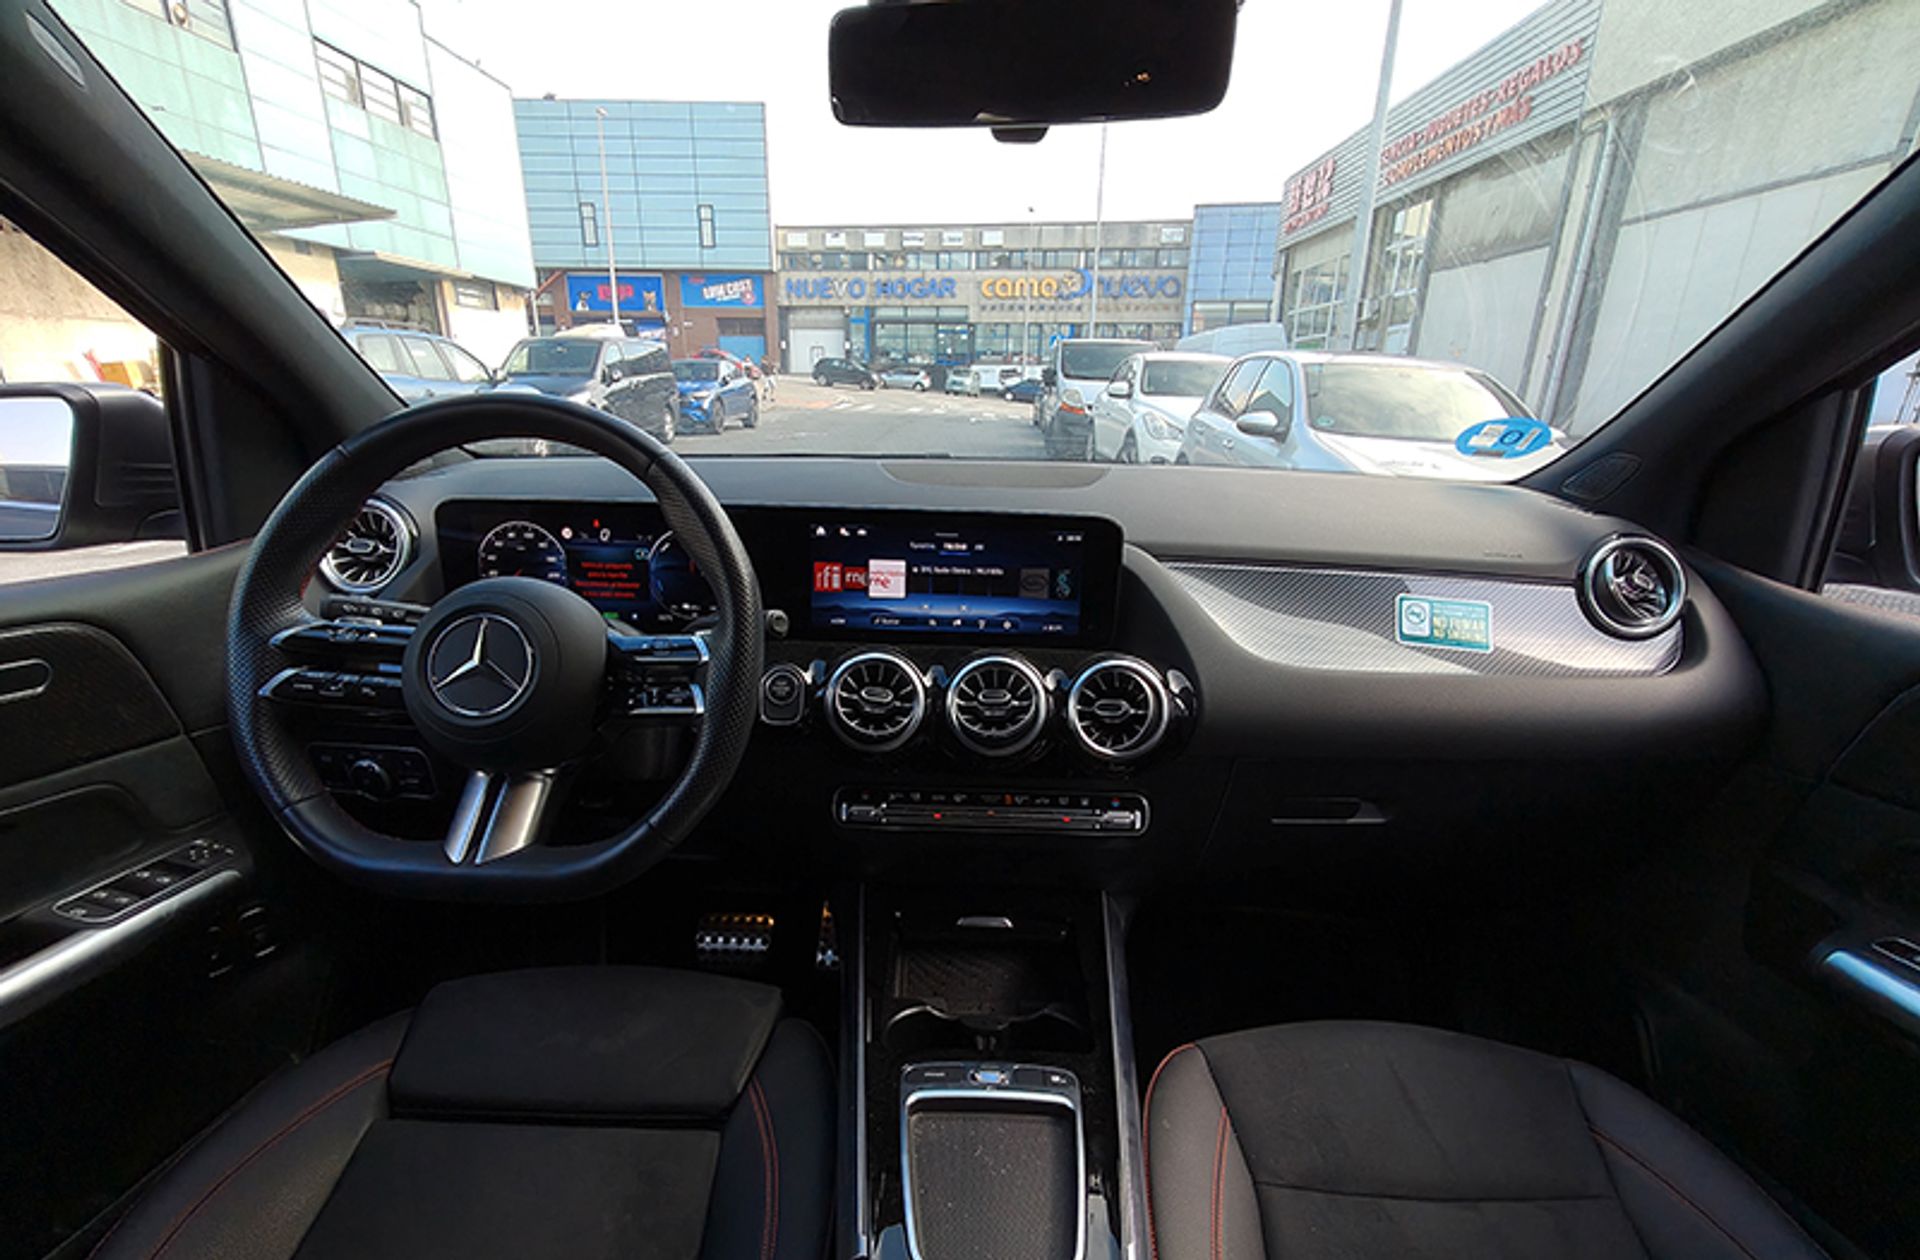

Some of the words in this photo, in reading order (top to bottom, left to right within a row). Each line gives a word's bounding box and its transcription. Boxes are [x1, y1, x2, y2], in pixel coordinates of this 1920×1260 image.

[785, 275, 867, 300] NUEVO
[875, 275, 958, 300] HOGAR
[816, 565, 841, 590] rfi
